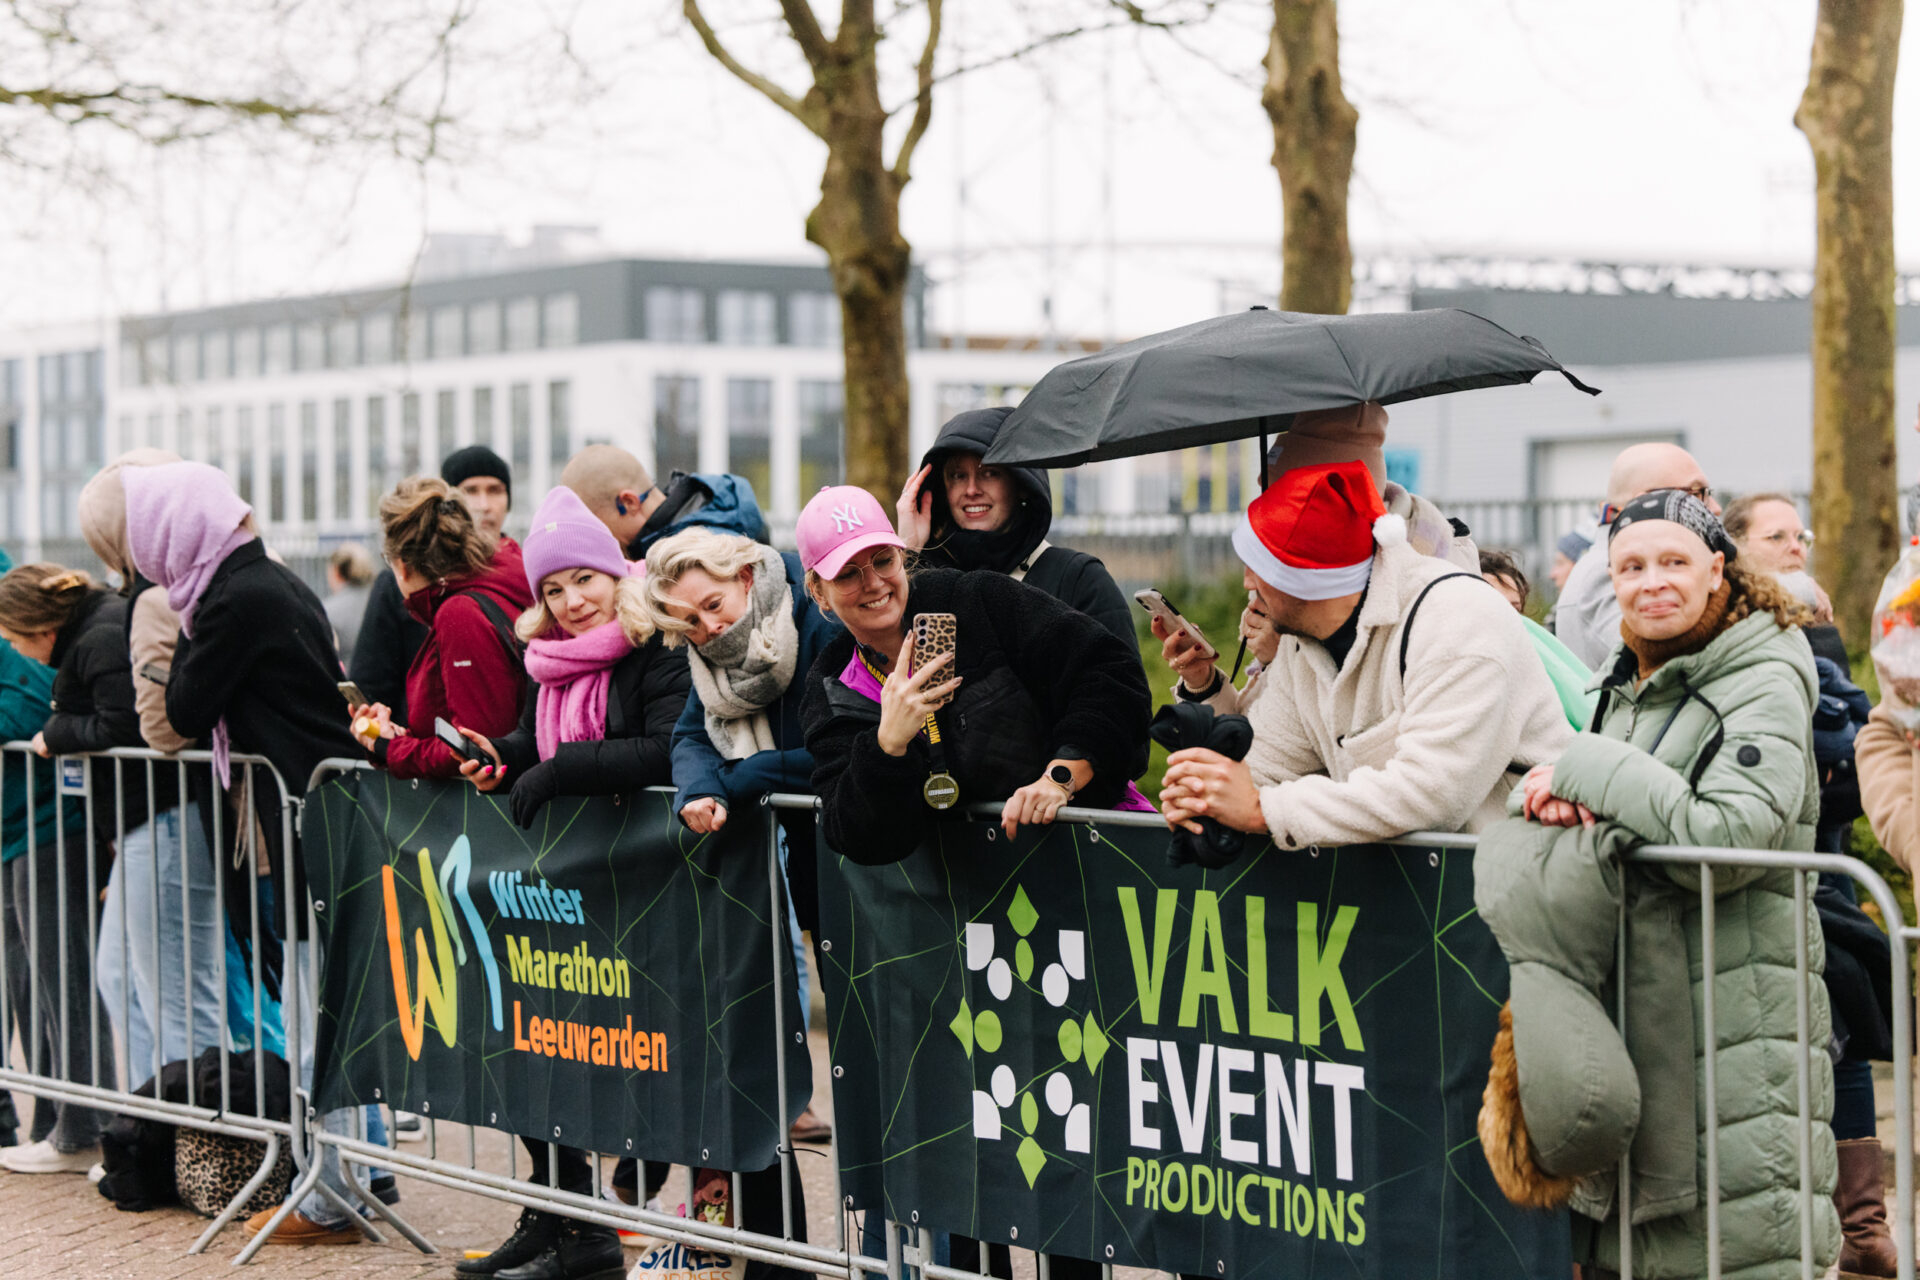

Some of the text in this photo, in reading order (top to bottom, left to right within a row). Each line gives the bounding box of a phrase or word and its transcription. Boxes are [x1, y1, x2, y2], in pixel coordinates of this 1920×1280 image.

[489, 869, 585, 925] Winter
[505, 934, 631, 999] Marathon
[1117, 886, 1366, 1052] VALK
[513, 1000, 669, 1073] Leeuwarden
[1126, 1036, 1366, 1181] EVENT
[1126, 1156, 1366, 1246] PRODUCTIONS
